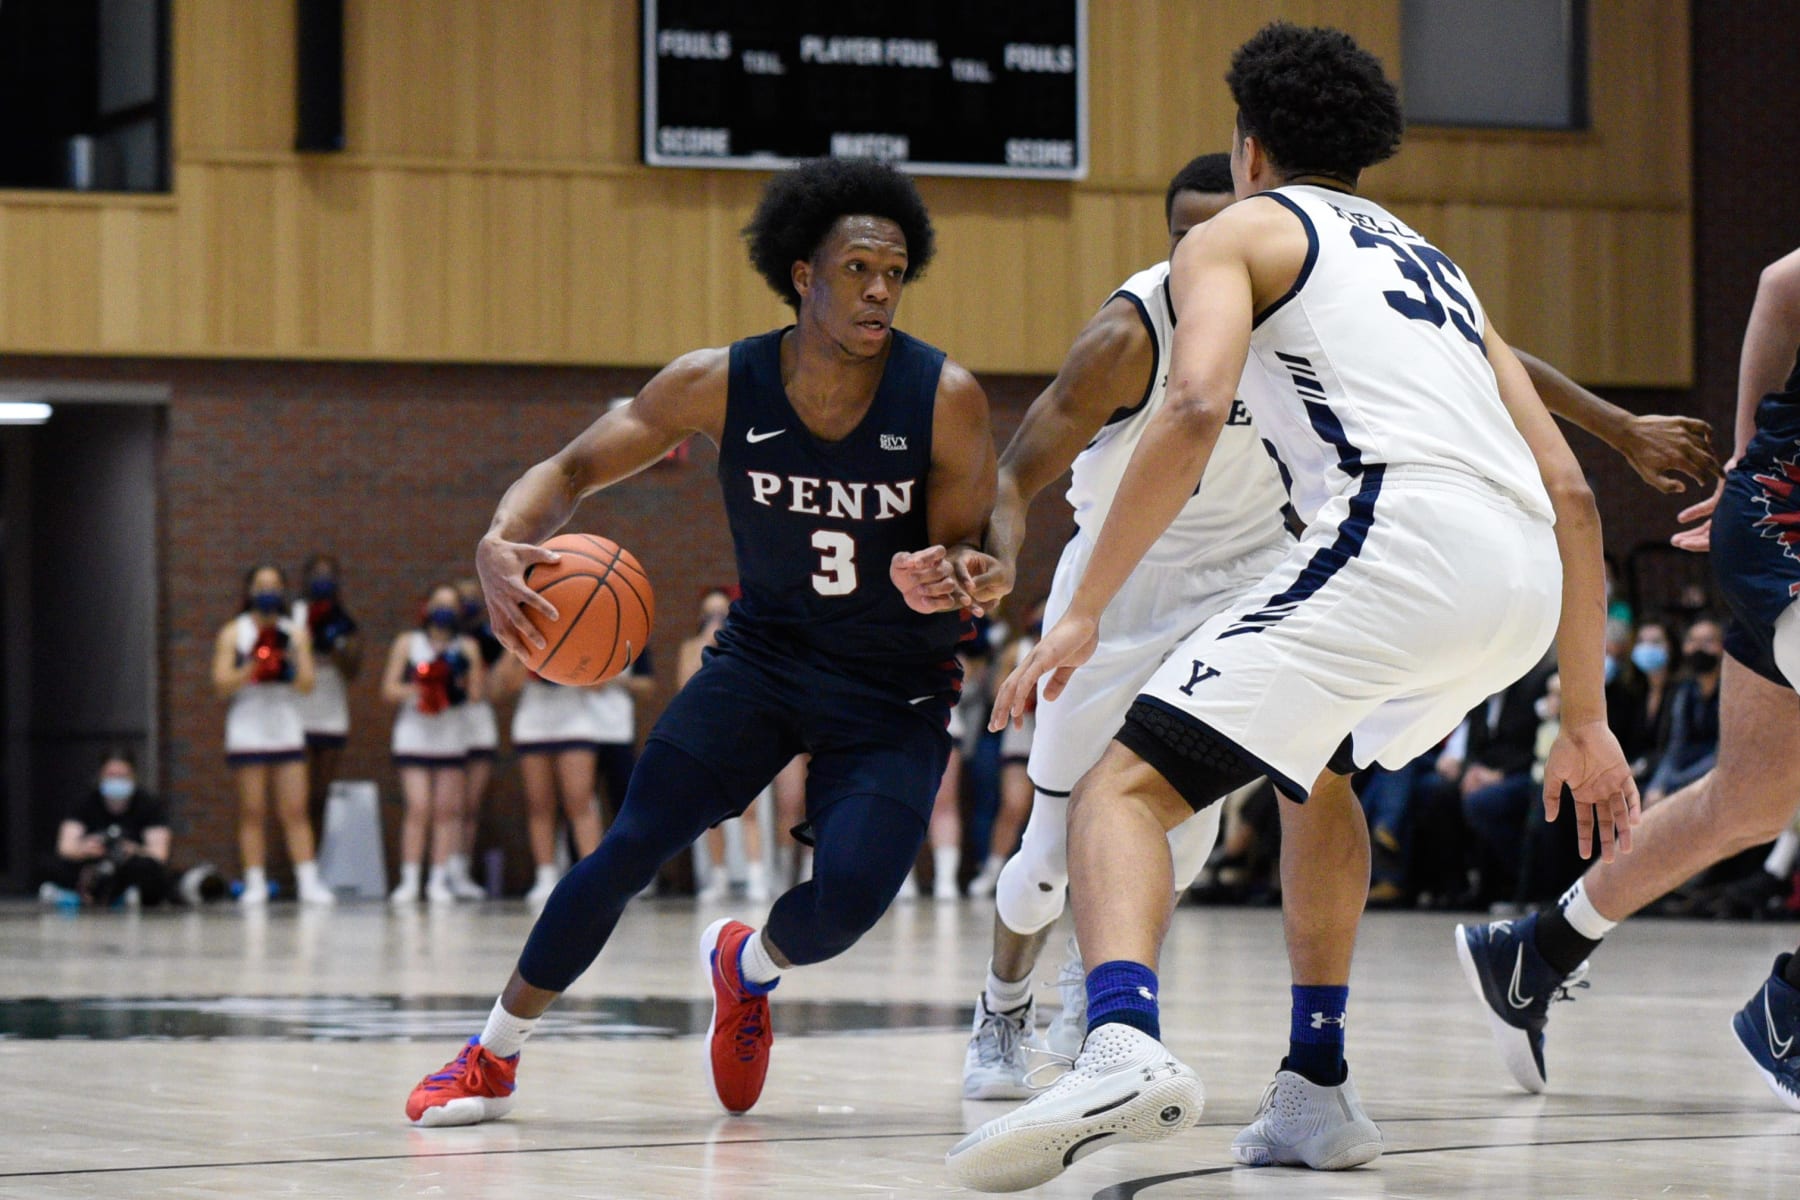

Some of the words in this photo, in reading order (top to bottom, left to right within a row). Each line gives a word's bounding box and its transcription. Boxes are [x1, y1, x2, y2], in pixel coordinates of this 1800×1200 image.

[659, 30, 731, 60] FOULS
[801, 35, 881, 66] PLAYER
[885, 38, 941, 69] FOUL
[1005, 43, 1074, 73] FOULS
[659, 127, 730, 156] SCORE
[830, 133, 909, 161] MATCH
[1006, 138, 1074, 167] SCORE
[1349, 225, 1488, 360] 35
[748, 471, 915, 520] PENN
[811, 530, 857, 596] 3
[1179, 659, 1221, 696] Y
